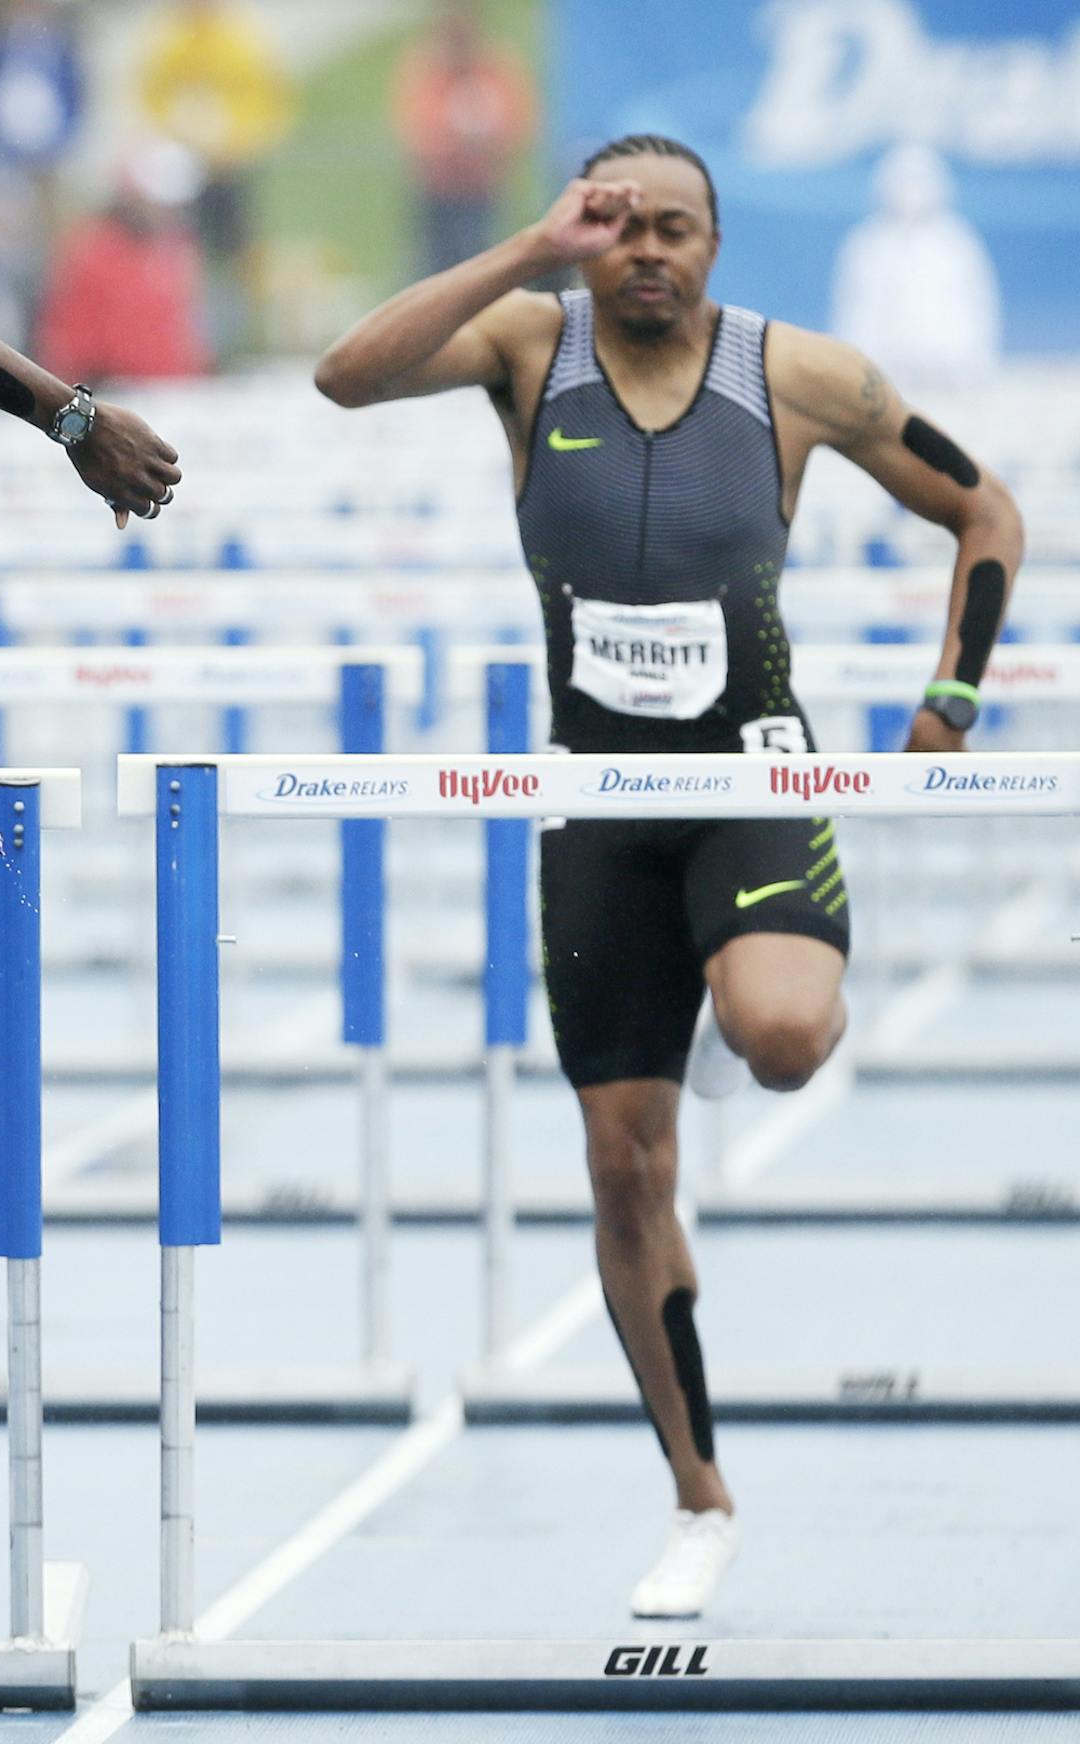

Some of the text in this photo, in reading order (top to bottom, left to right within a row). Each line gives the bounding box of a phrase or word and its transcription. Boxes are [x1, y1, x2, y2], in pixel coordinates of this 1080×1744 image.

[590, 637, 707, 665] MERRITT
[275, 766, 1058, 804] Drake RELAYS HyVee Drake RELAYS HyVee Drake RELAYS
[604, 1646, 708, 1675] GILL
